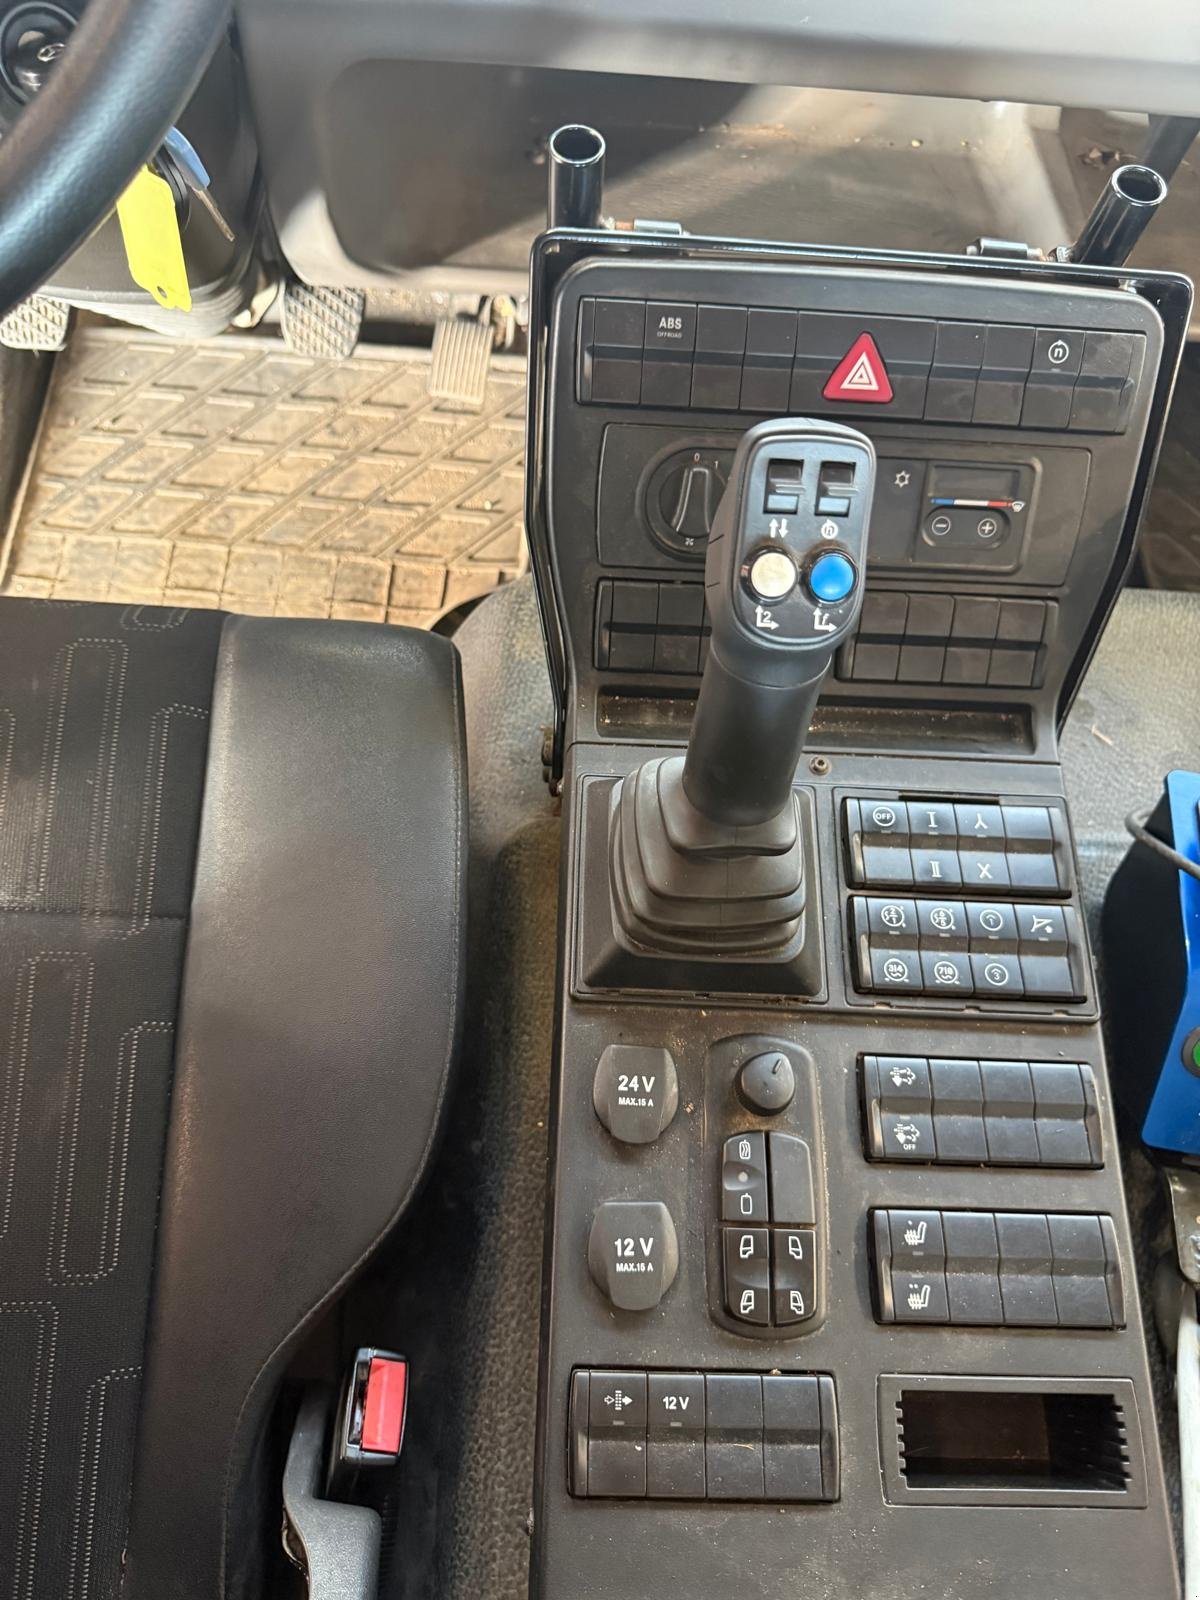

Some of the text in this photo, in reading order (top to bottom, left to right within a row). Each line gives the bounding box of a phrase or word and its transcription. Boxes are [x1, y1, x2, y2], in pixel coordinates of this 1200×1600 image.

[659, 316, 682, 330] ABS
[694, 452, 701, 462] 0
[763, 611, 772, 623] 2
[875, 812, 892, 820] OFF
[618, 1074, 656, 1093] 24 V
[618, 1096, 654, 1107] MAX.15 A
[614, 1237, 654, 1257] 12 V
[646, 1262, 654, 1273] A
[662, 1396, 690, 1410] 12 V
